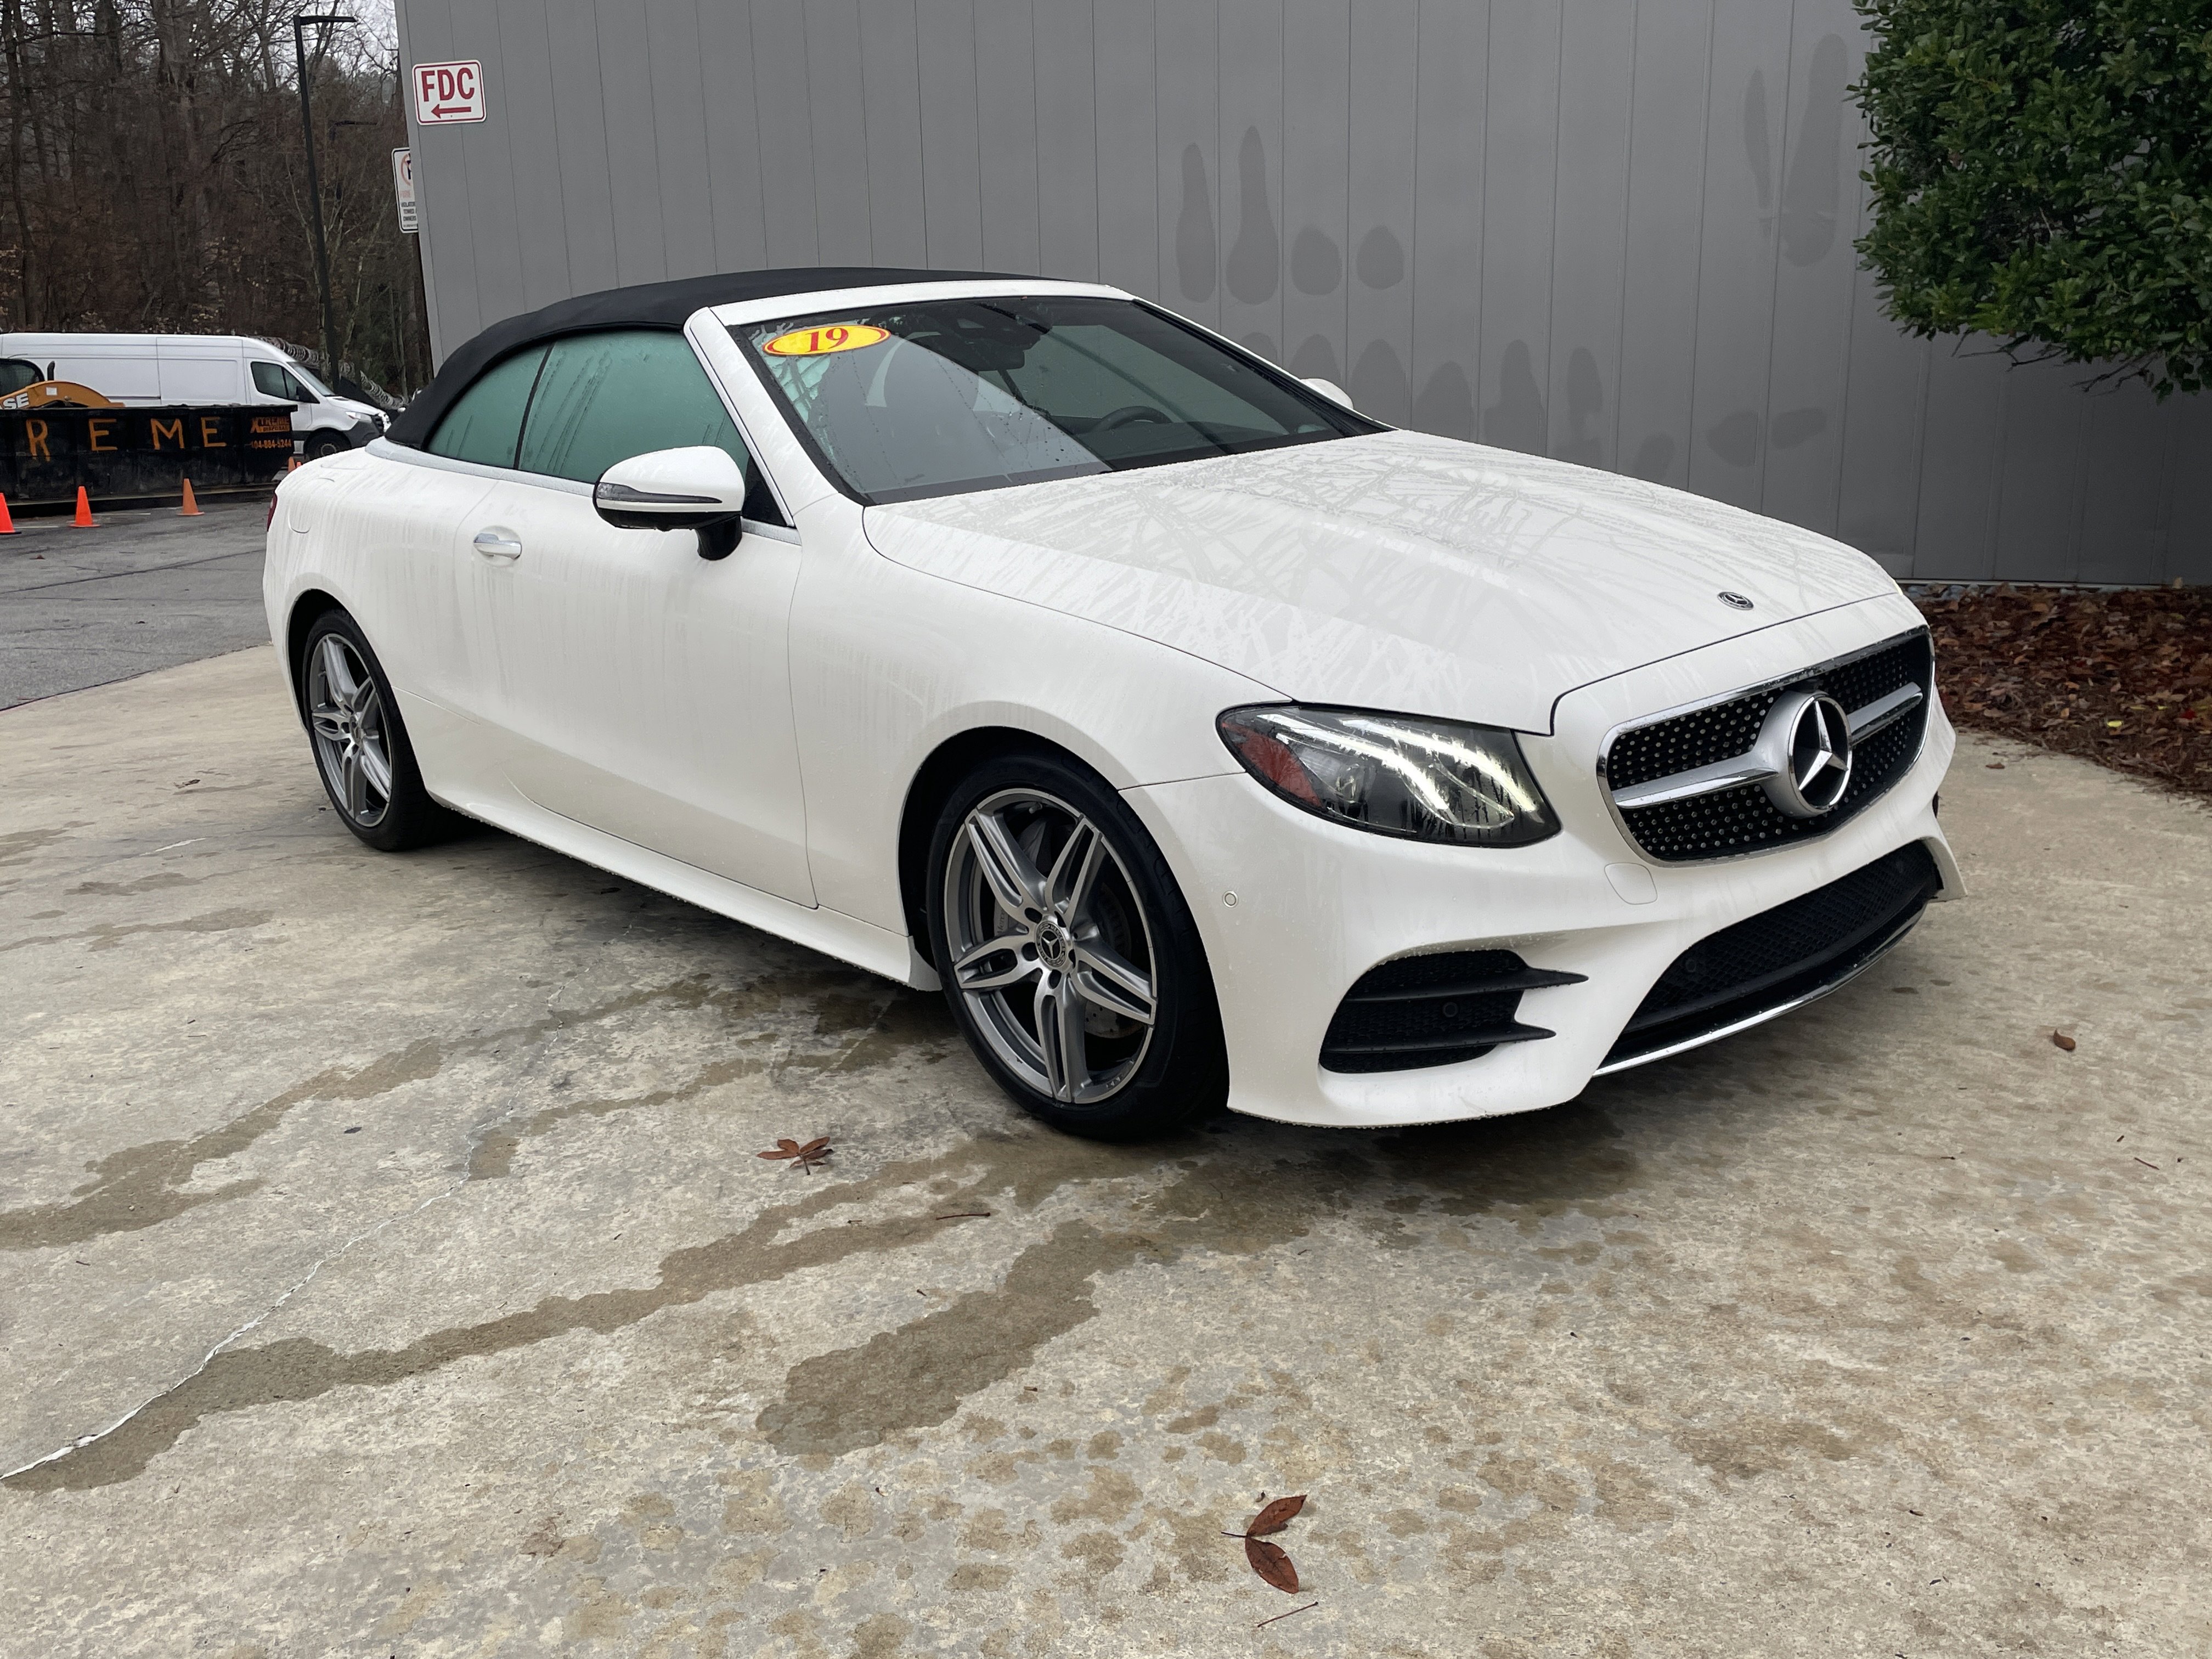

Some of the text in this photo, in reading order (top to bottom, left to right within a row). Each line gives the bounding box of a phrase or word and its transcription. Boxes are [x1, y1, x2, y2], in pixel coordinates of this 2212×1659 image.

[421, 67, 475, 102] FDC
[804, 328, 849, 353] 19
[0, 393, 30, 409] SE
